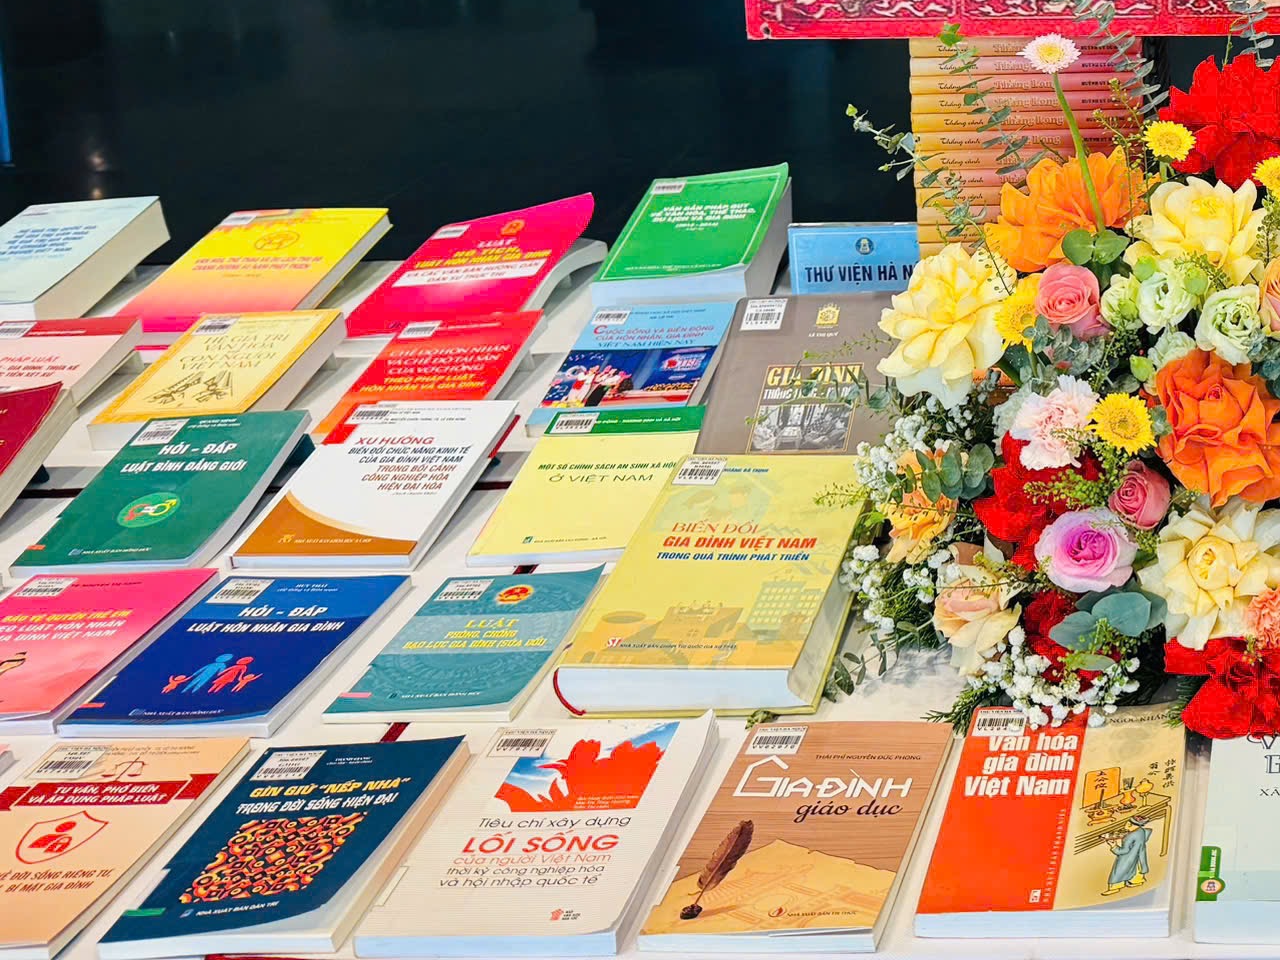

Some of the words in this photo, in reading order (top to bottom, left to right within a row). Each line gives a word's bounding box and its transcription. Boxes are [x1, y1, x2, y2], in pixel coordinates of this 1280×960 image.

[806, 265, 835, 284] THƯ
[840, 264, 871, 285] VIỆN
[878, 261, 898, 281] HÀ
[159, 442, 189, 455] HỎI
[203, 442, 238, 454] ĐÁP
[121, 462, 149, 474] LUẬT
[569, 474, 609, 483] VIỆT
[663, 536, 691, 547] GIA
[695, 534, 736, 548] ĐÌNH
[741, 536, 772, 551] VIỆT
[777, 538, 818, 548] NAM
[657, 552, 690, 561] TRONG
[750, 551, 777, 561] PHÁT
[238, 606, 272, 617] HỎI
[289, 606, 328, 616] ĐÁP
[187, 622, 221, 633] LUẬT
[225, 622, 249, 632] HÔN
[251, 622, 288, 632] NHÂN
[289, 622, 311, 632] GIA
[314, 620, 343, 631] ĐÌNH
[1036, 734, 1078, 751] hóa
[982, 756, 1017, 772] gia
[1025, 753, 1074, 771] đình
[816, 768, 913, 798] ĐÌNH
[964, 776, 1010, 797] Việt
[1016, 777, 1071, 795] Nam
[28, 794, 46, 803] VÀ
[67, 795, 101, 804] DỤNG
[102, 793, 134, 802] PHÁP
[136, 793, 168, 802] LUẬT
[250, 786, 283, 798] GÌN
[1260, 787, 1280, 796] XÃ
[235, 803, 278, 814] TRONG
[304, 796, 339, 811] SỐNG
[342, 796, 373, 811] HIỆN
[375, 793, 398, 809] ĐẠI
[794, 799, 852, 822] giáo
[857, 799, 903, 819] dục
[479, 817, 515, 829] Tiêu
[521, 816, 547, 828] chí
[548, 817, 578, 830] xây
[586, 815, 632, 829] dựng
[462, 832, 516, 853] LỐI
[522, 830, 620, 853] SỐNG
